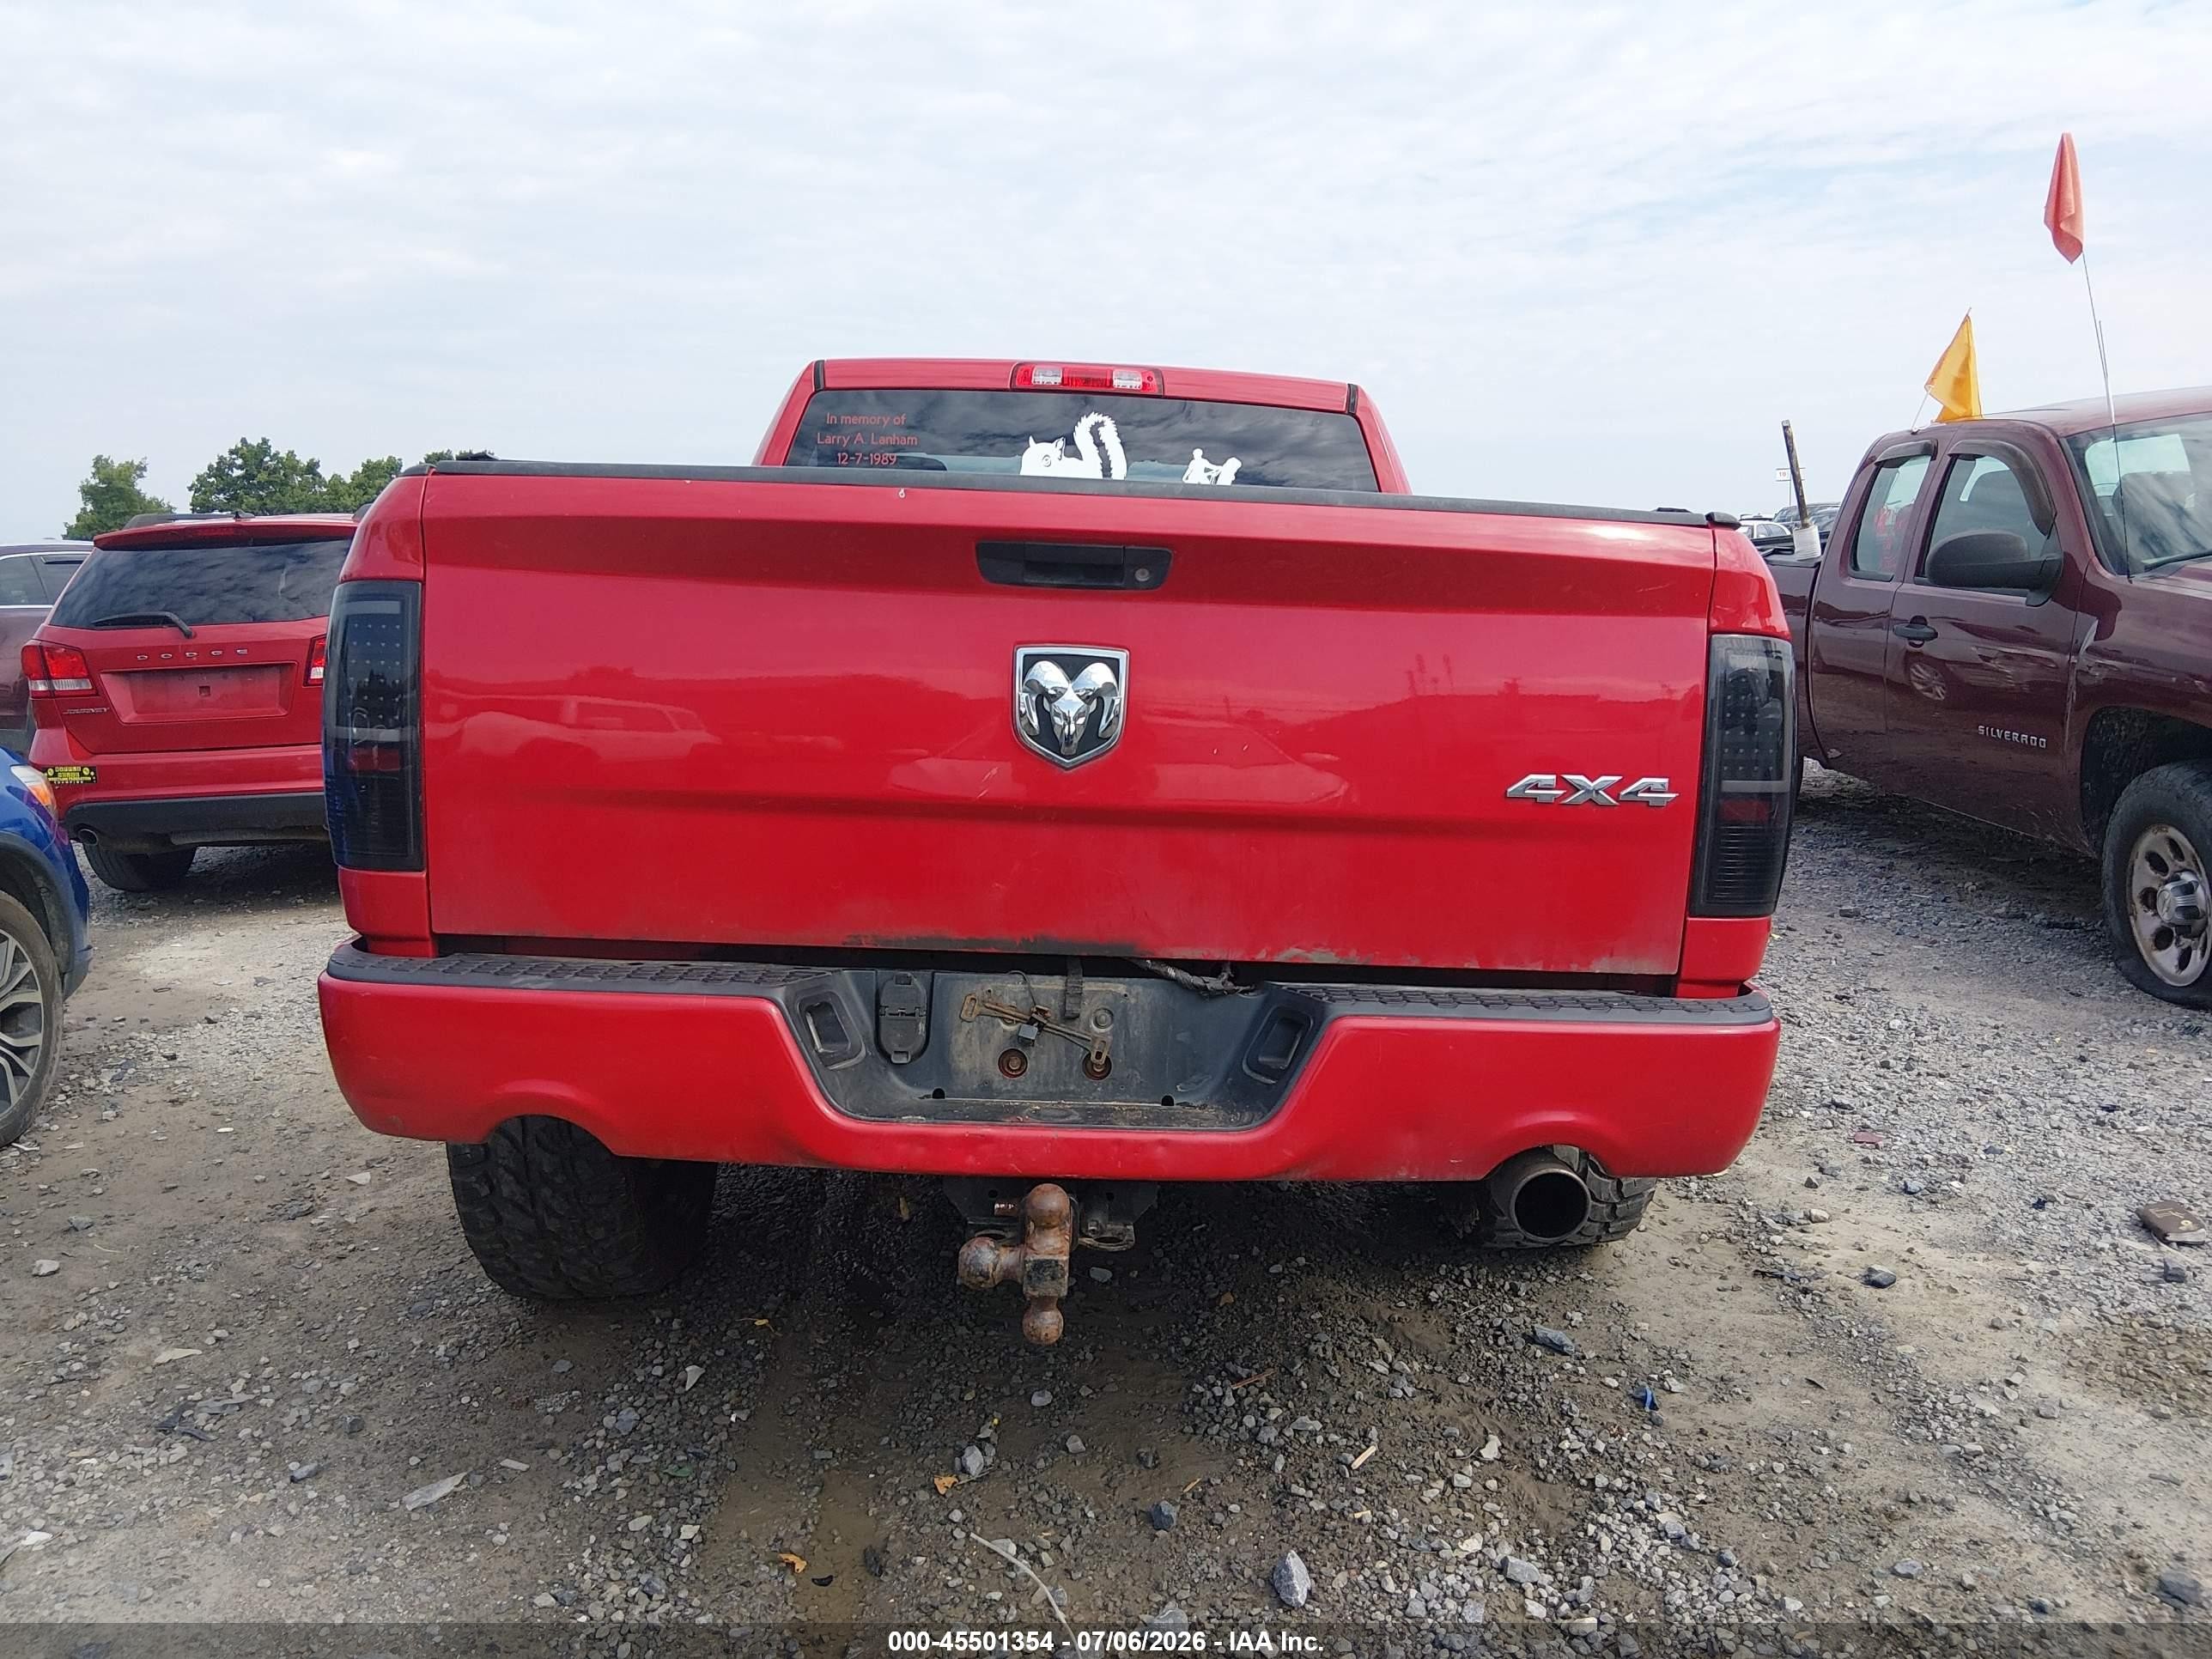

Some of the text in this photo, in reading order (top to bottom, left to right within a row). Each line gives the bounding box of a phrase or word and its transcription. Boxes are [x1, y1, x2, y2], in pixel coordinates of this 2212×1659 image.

[826, 412, 907, 428] In memory of
[817, 432, 850, 447] Larry
[871, 432, 918, 446] Lanham
[837, 452, 897, 465] 12-7-1989
[137, 648, 248, 660] DODGE
[1978, 725, 2047, 750] SILVERADO
[1506, 774, 1680, 806] 4X4
